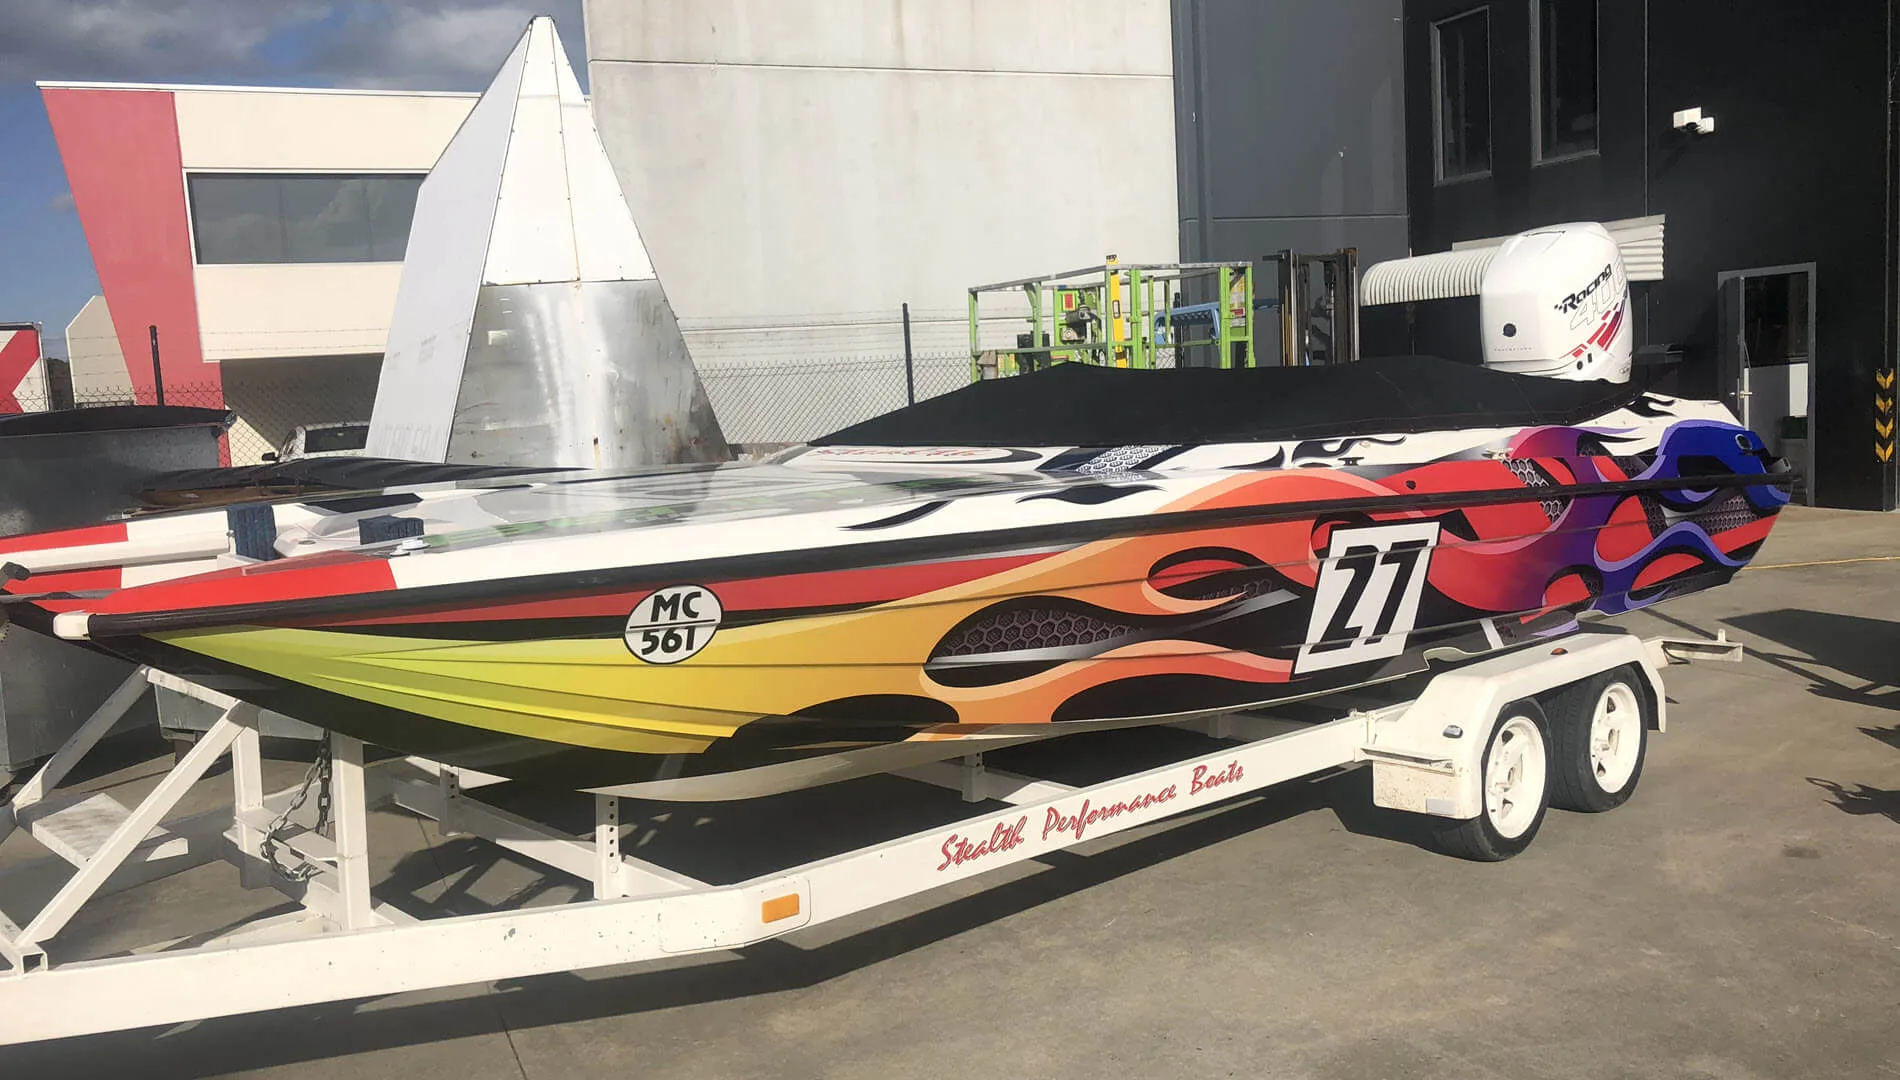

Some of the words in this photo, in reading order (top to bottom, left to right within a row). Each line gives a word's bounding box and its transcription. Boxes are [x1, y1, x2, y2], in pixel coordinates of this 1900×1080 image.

[1562, 263, 1612, 314] Racing
[650, 591, 702, 622] MC
[1307, 538, 1430, 655] 27
[641, 625, 696, 656] 561
[936, 815, 1028, 872] Stealth
[1041, 783, 1177, 842] Performance
[1189, 760, 1244, 796] Boats
